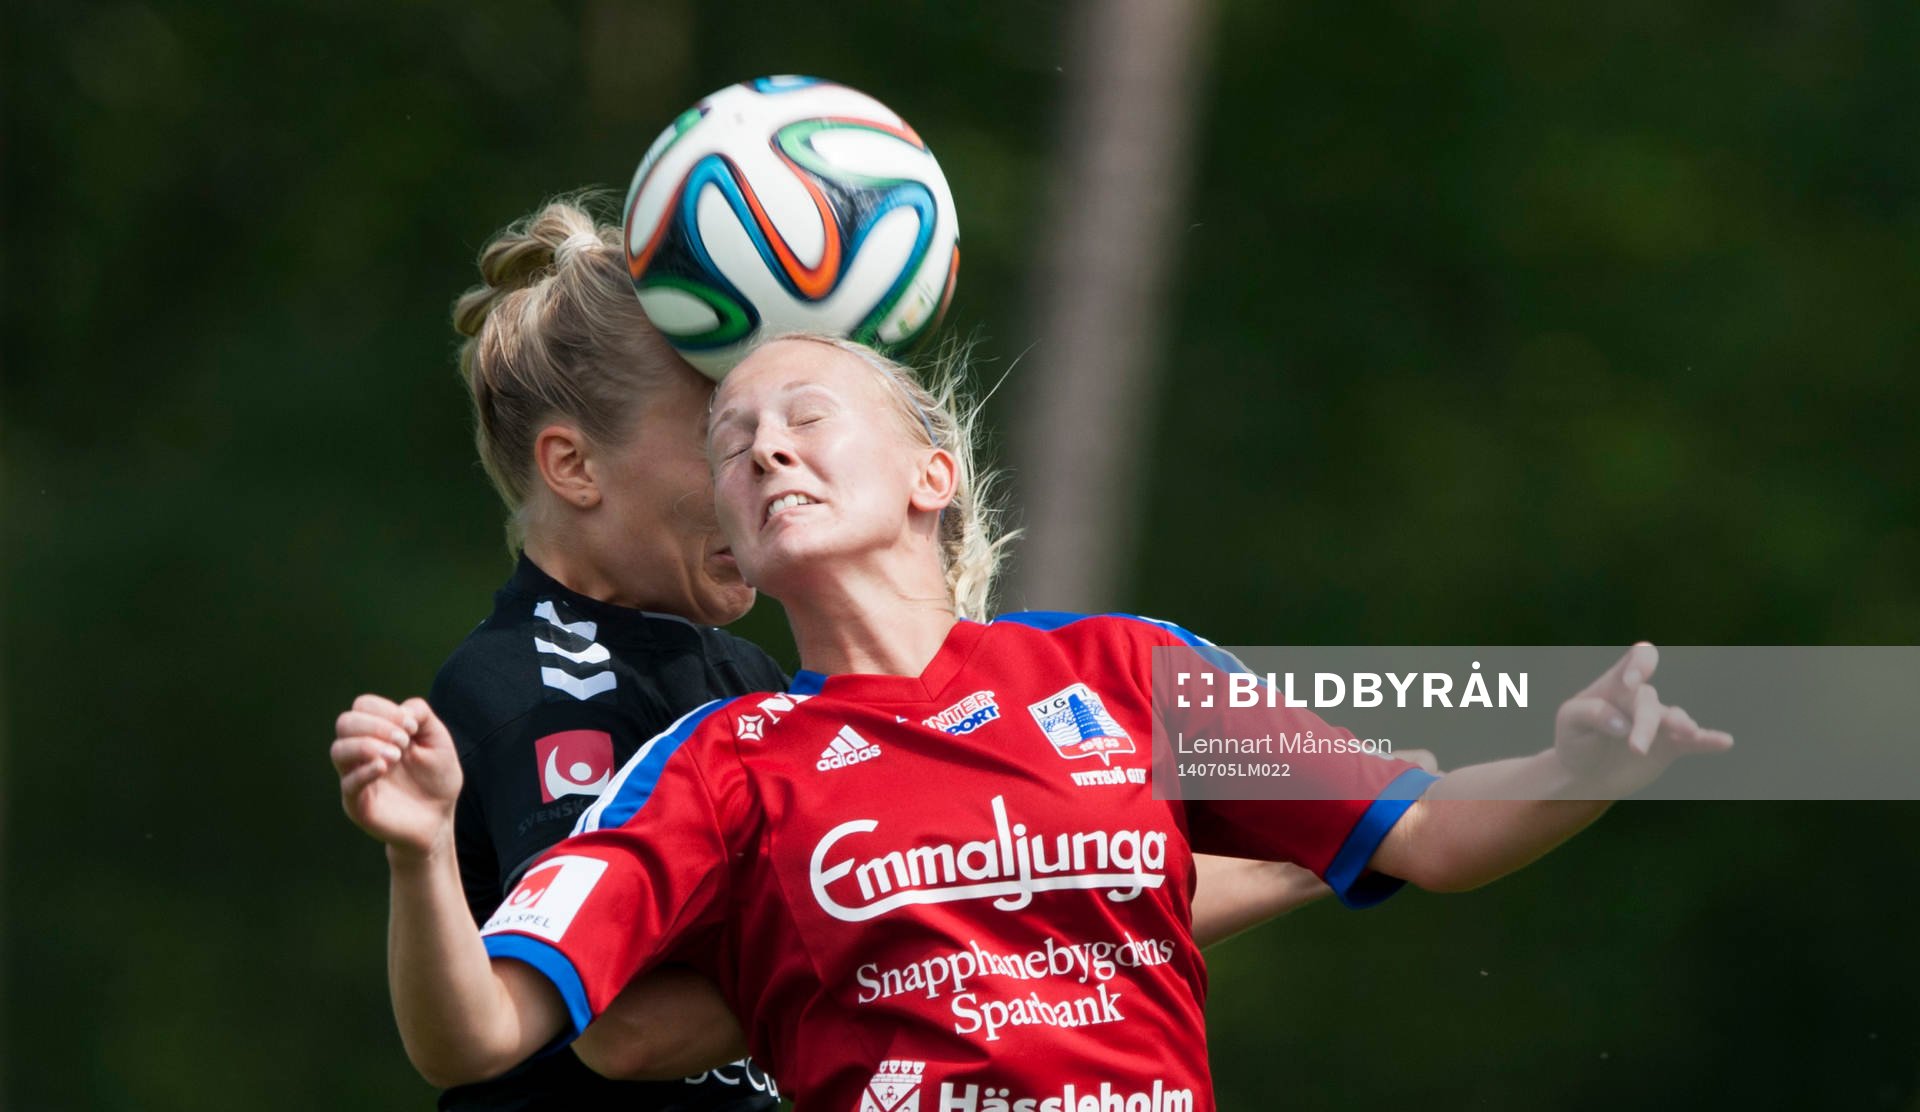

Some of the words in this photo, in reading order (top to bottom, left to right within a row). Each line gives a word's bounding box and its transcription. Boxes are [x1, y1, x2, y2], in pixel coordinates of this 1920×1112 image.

[921, 690, 995, 731] NTER
[816, 744, 881, 771] adidas
[517, 798, 588, 837] SVENSK
[809, 794, 1166, 922] Emmaljunga
[856, 931, 1176, 1004] Snapphanebygdens
[950, 984, 1125, 1042] Sparbank
